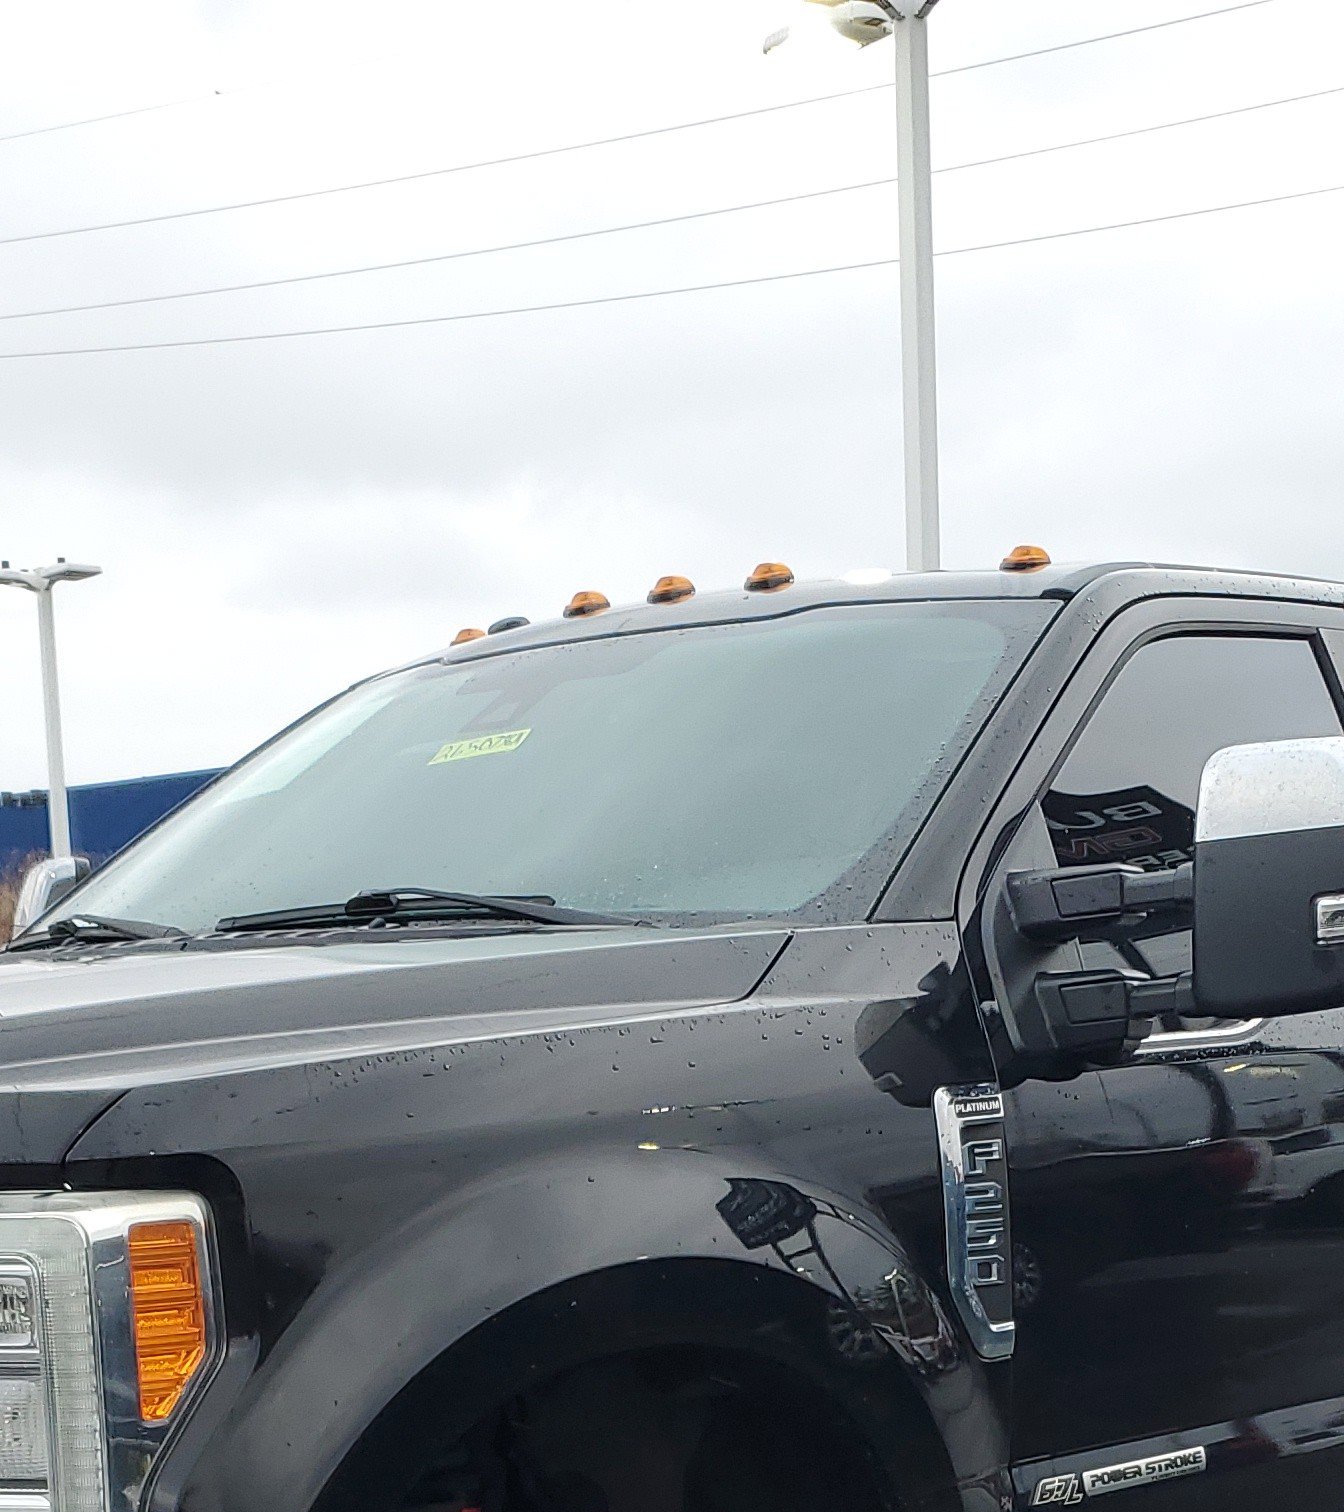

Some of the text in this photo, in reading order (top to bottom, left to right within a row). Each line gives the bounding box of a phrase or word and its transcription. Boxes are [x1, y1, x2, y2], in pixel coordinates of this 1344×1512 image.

[955, 1100, 1000, 1114] PLATINUM
[962, 1138, 1005, 1286] F250
[1090, 1465, 1143, 1488] POWER
[1145, 1450, 1205, 1476] STROKE
